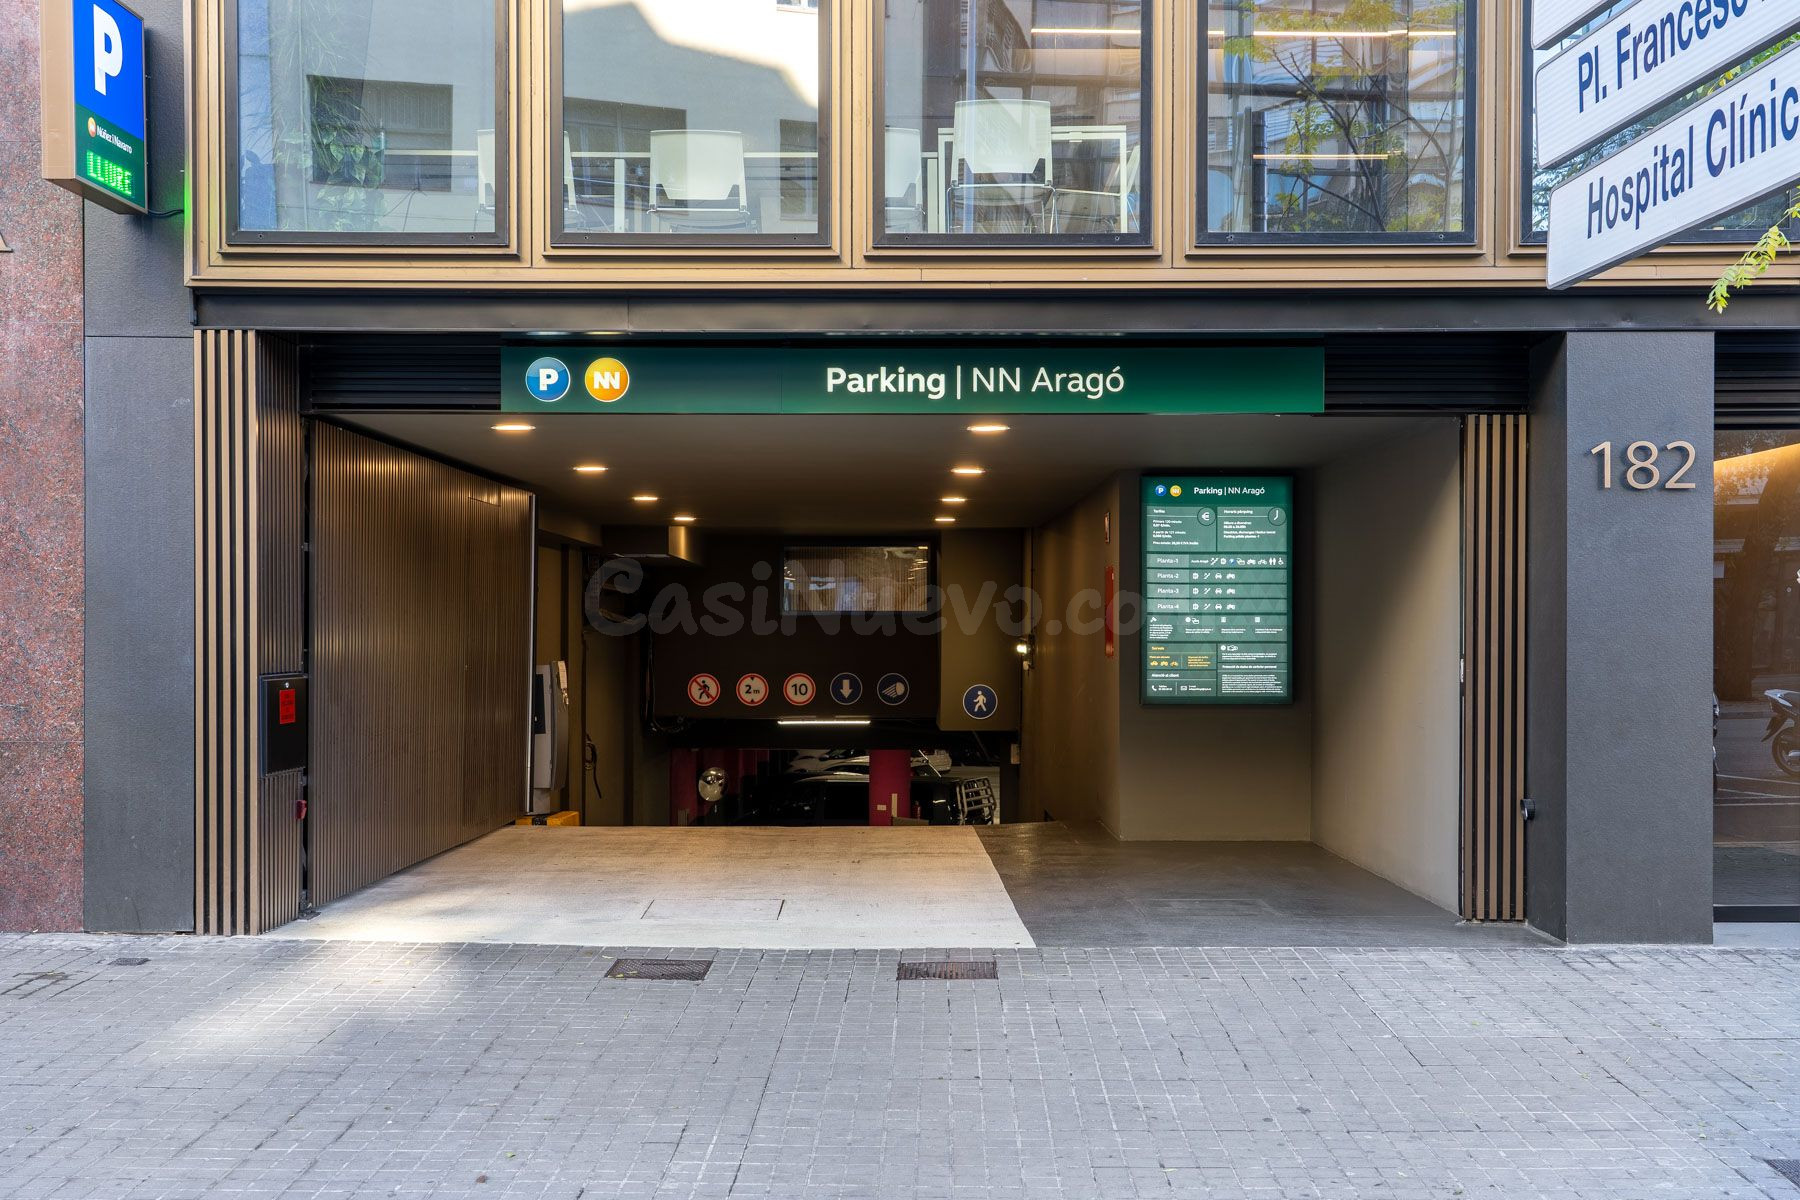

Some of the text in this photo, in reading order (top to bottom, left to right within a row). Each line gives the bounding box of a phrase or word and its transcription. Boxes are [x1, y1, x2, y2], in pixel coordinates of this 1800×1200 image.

[93, 3, 123, 96] P
[1578, 45, 1607, 113] Pl.
[87, 149, 132, 197] LLIURE
[1587, 77, 1799, 239] Hospital Clínic
[539, 368, 559, 391] P
[826, 365, 1125, 400] Parking NN Aragó
[1590, 440, 1696, 490] 182
[1193, 487, 1223, 496] Parking
[1242, 487, 1266, 496] Aragó
[791, 683, 808, 695] 10
